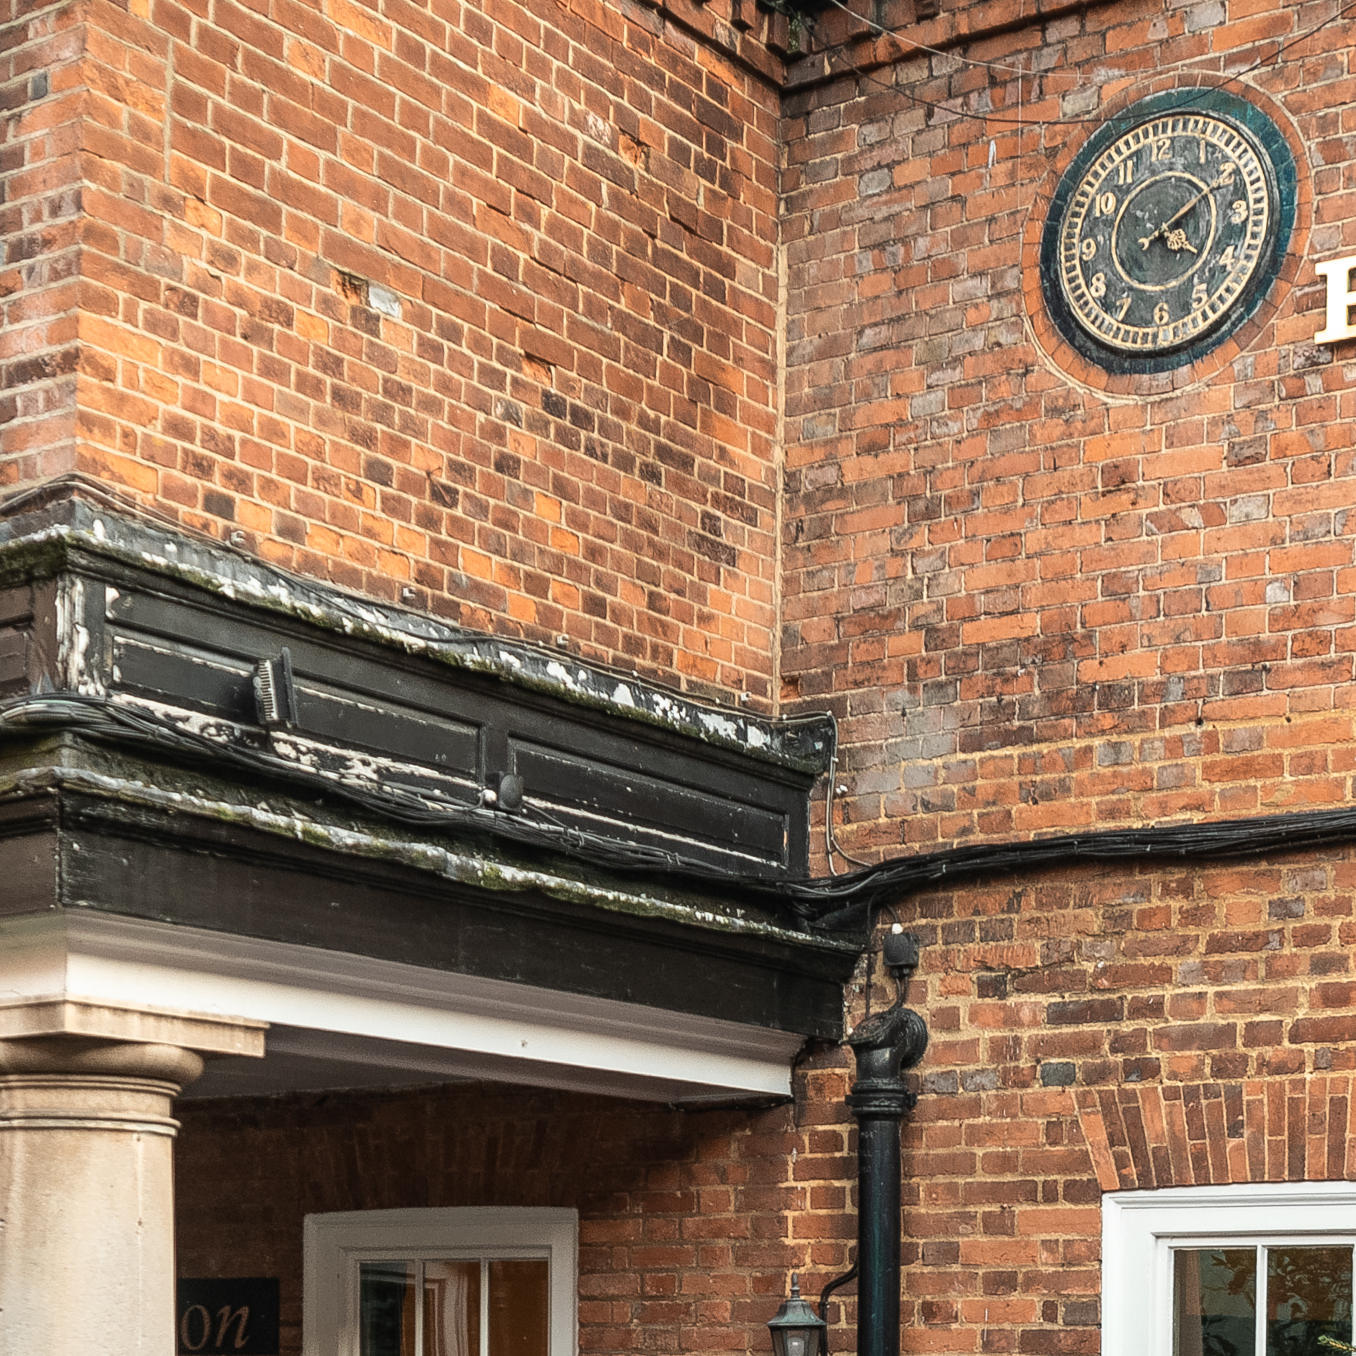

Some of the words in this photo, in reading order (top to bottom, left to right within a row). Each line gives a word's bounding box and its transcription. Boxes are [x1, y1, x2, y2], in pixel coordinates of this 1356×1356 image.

[1150, 138, 1172, 162] 12
[1198, 140, 1207, 164] 1
[1117, 162, 1134, 185] 11
[1095, 192, 1116, 217] 10
[1231, 200, 1248, 223] 3
[1081, 237, 1097, 261] 9
[1219, 245, 1235, 271] 4
[1090, 272, 1107, 298] 8
[1191, 283, 1208, 308] 5
[1115, 297, 1132, 321] 7
[1153, 302, 1170, 324] 6
